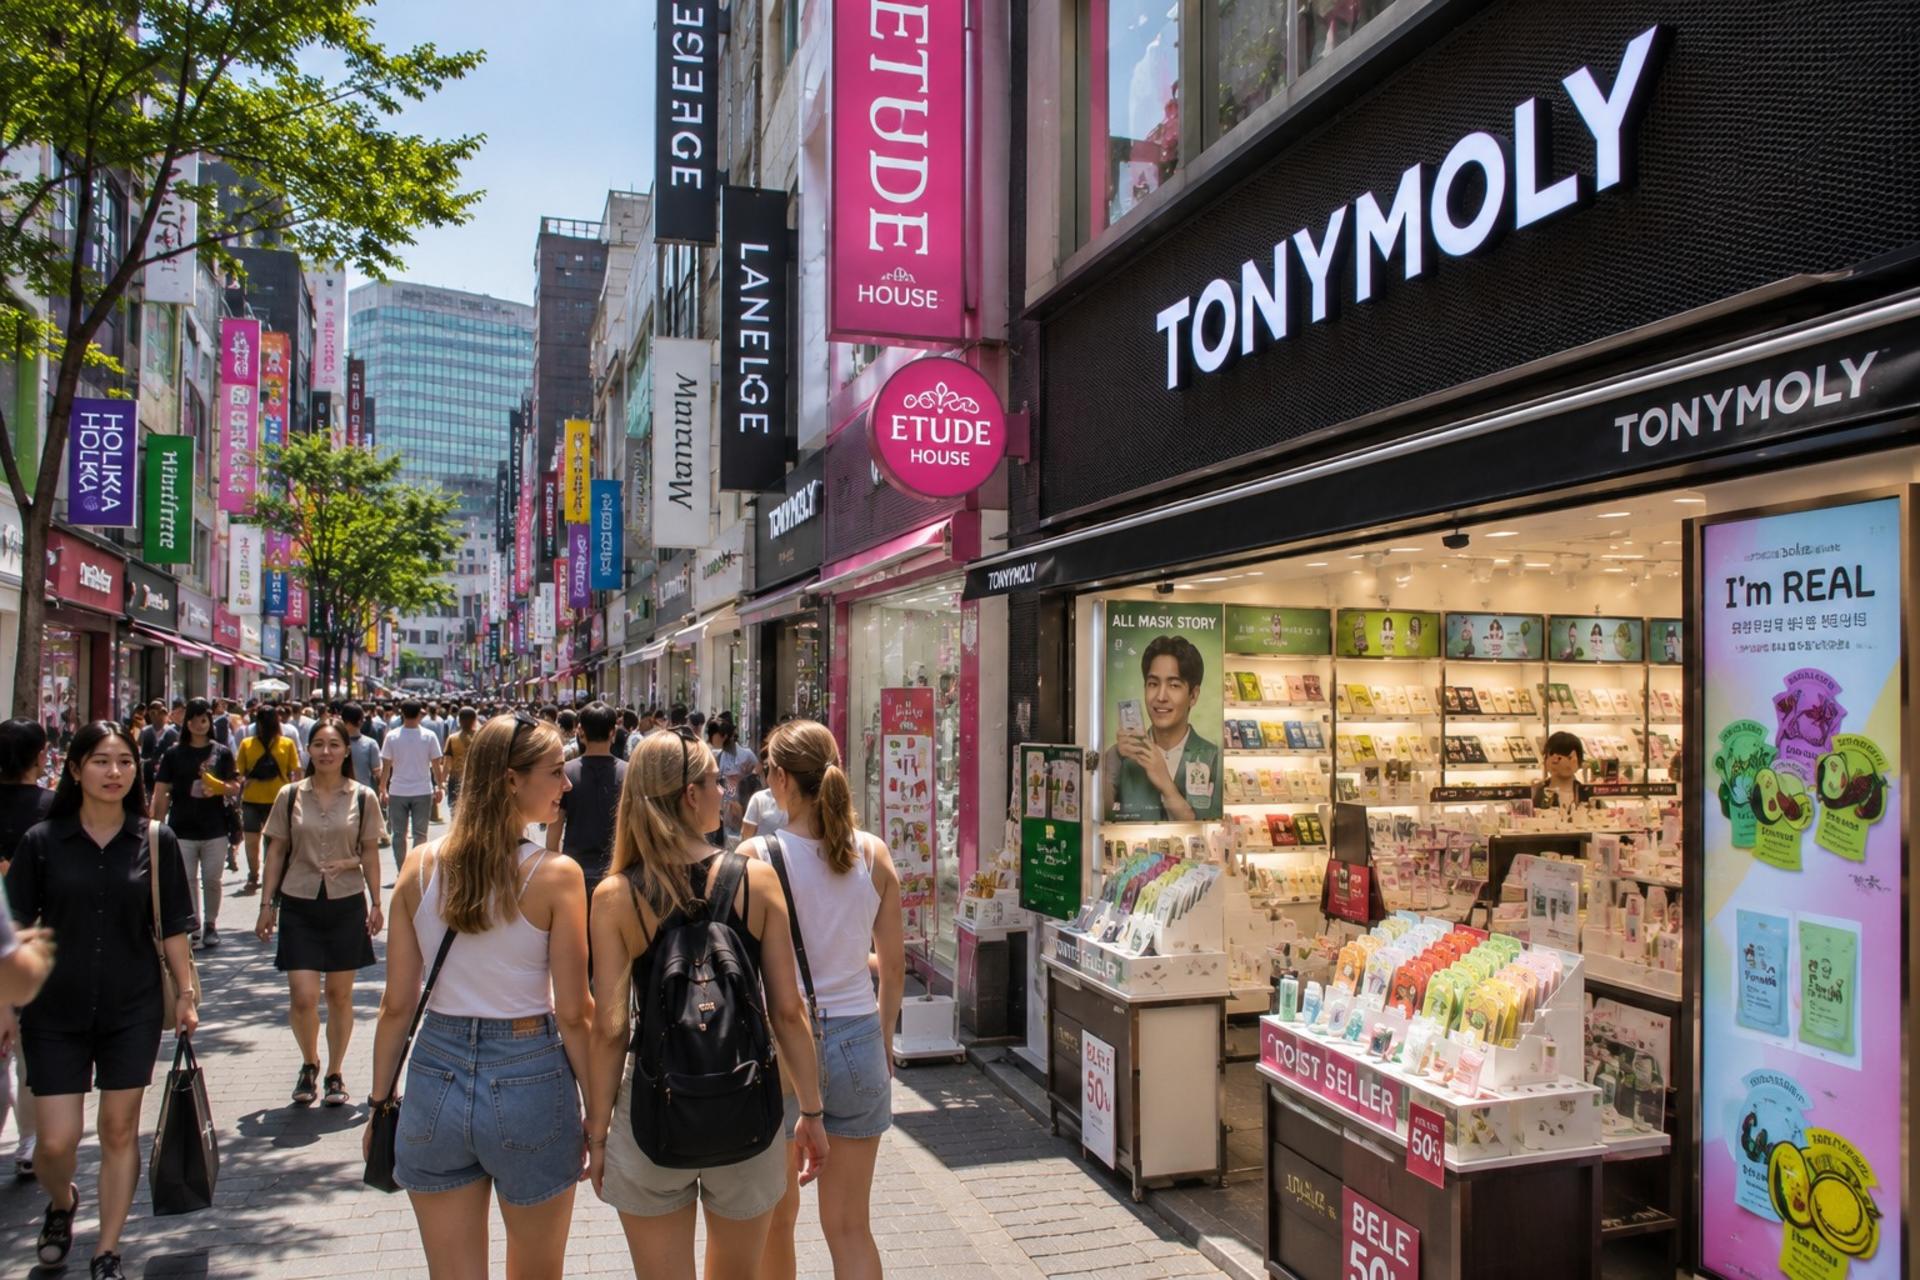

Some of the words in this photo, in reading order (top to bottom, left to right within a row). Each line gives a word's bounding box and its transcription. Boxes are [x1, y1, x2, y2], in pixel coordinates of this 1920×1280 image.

[869, 0, 929, 256] ETUDE
[1156, 24, 1658, 391] TONYMOLY
[858, 284, 938, 309] HOUSE
[1614, 351, 1878, 453] TONYMOLY
[891, 415, 991, 445] ETUDE
[910, 448, 970, 466] HOUSE
[988, 562, 1037, 591] TONYMOLY
[1726, 576, 1771, 608] I'm
[1784, 565, 1875, 604] REAL
[1112, 614, 1134, 628] ALL
[1138, 615, 1174, 628] MASK
[1177, 616, 1217, 631] STORY
[1325, 1063, 1393, 1118] SELLER
[1350, 1240, 1396, 1280] 50
